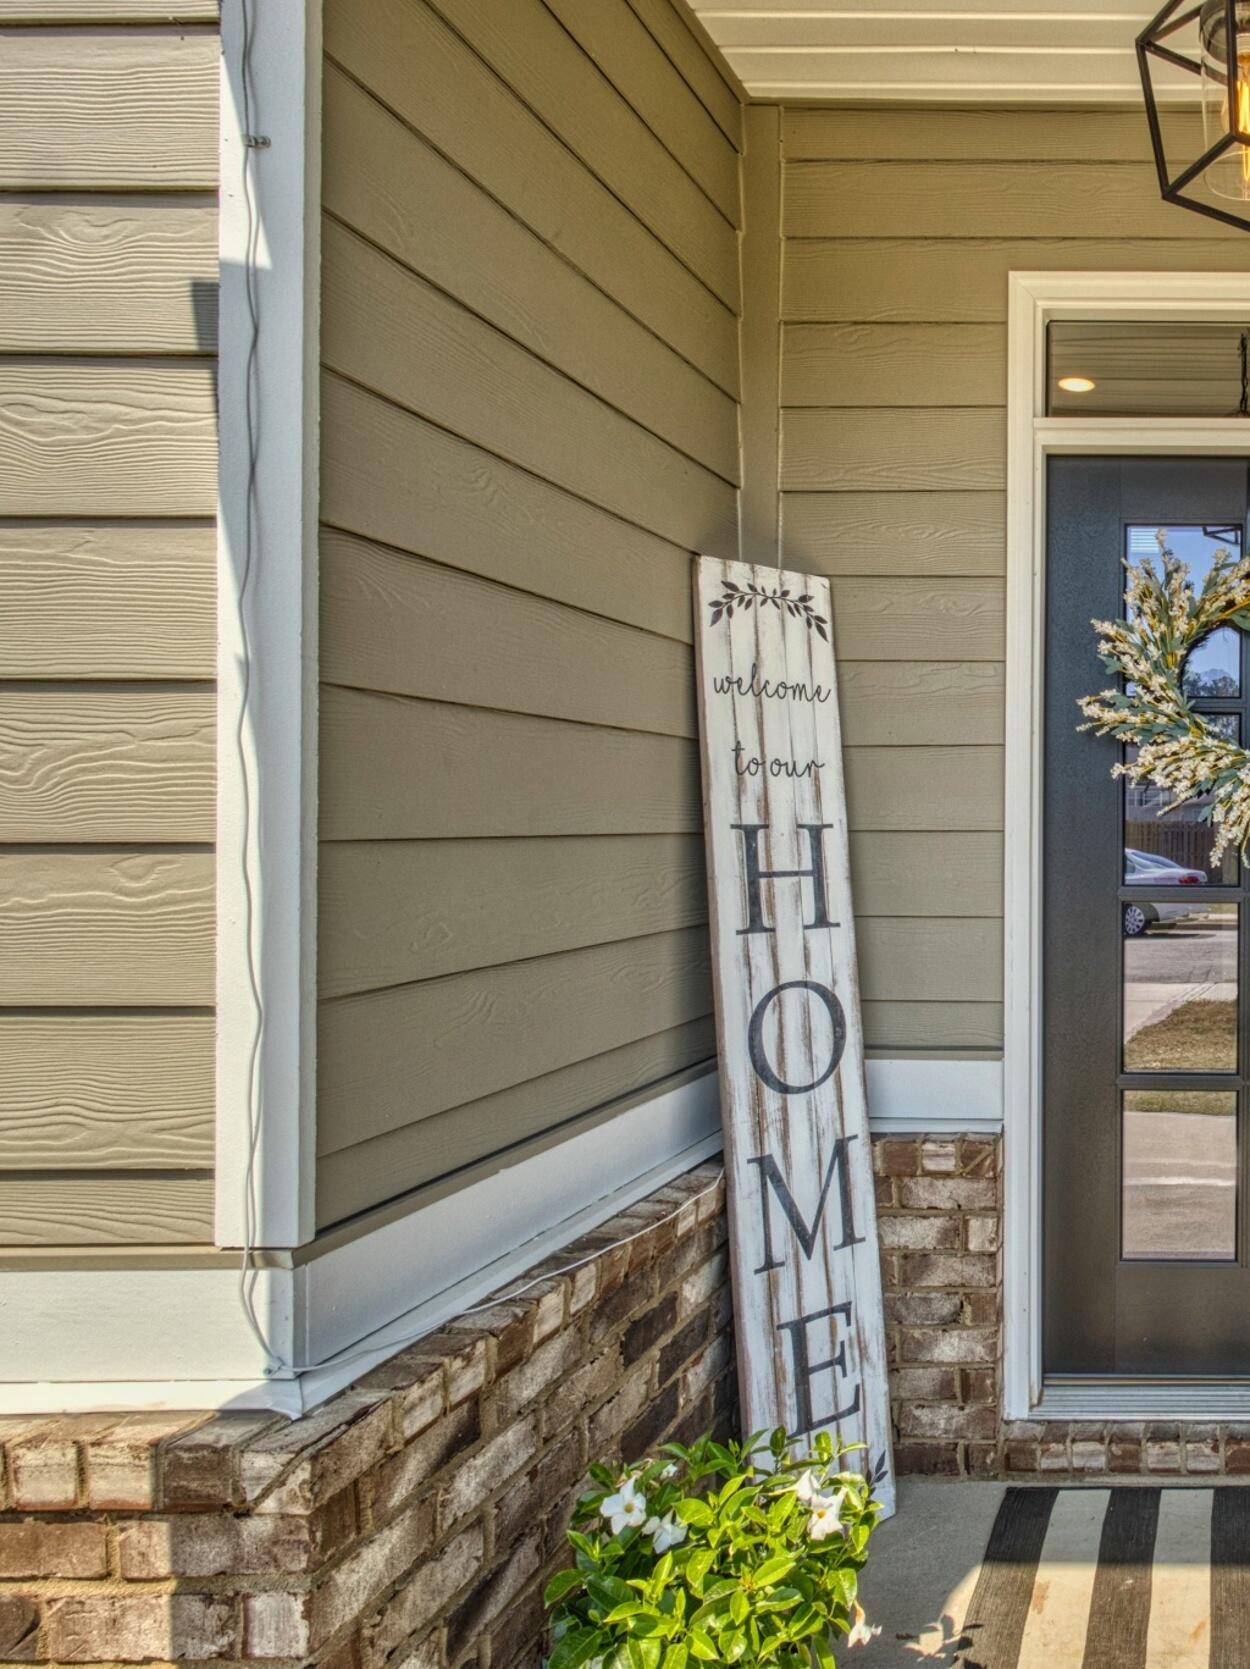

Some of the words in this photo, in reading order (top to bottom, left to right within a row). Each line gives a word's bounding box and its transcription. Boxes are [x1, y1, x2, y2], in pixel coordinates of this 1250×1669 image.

[713, 662, 831, 703] welcome
[731, 740, 765, 777] to
[769, 757, 826, 778] our
[730, 823, 866, 1439] HOME
